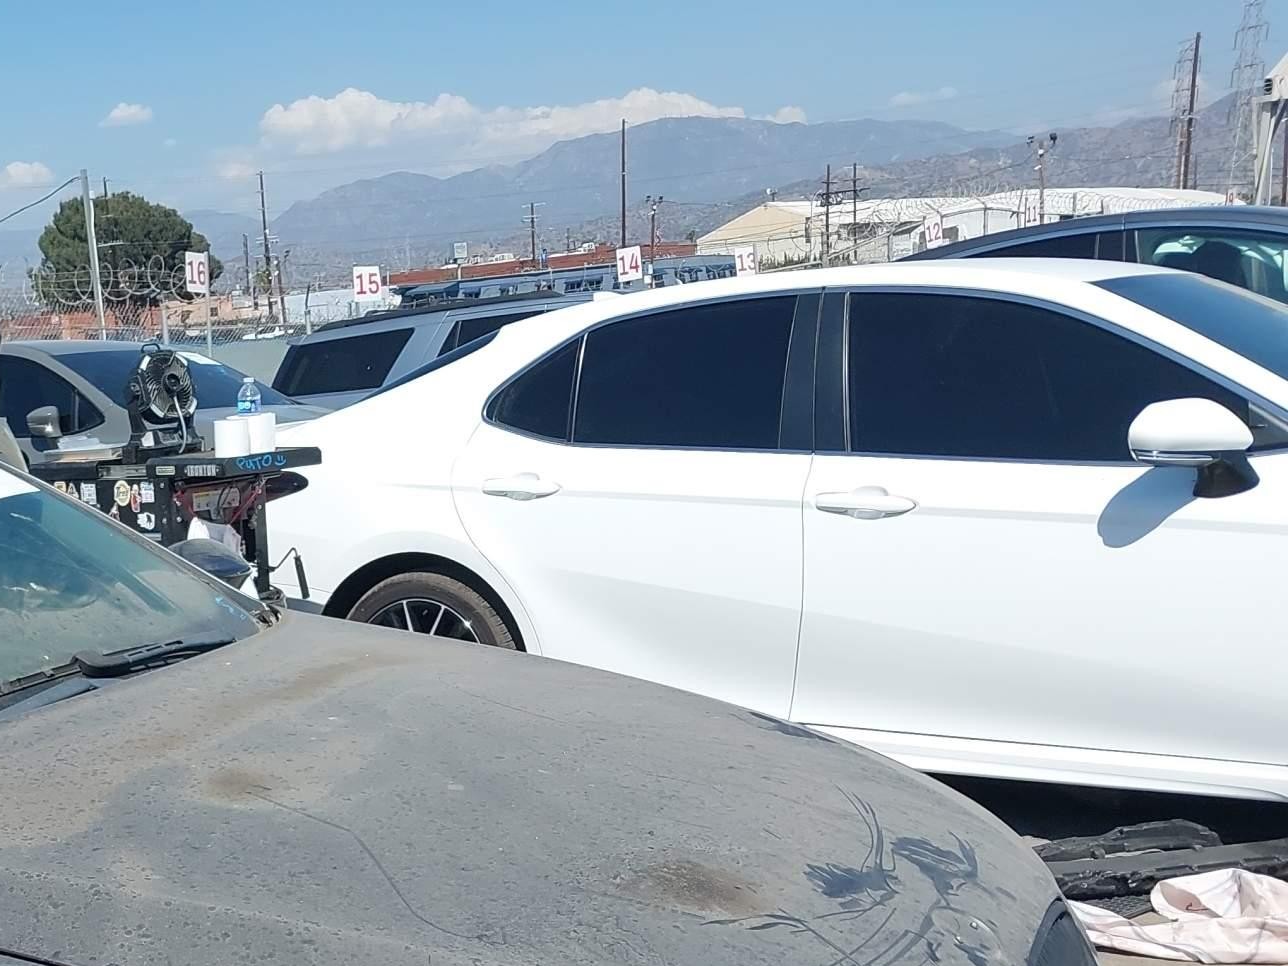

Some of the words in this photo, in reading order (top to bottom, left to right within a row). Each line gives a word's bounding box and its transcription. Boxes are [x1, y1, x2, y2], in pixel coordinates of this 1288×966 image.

[926, 222, 941, 243] 12
[187, 260, 206, 285] 16
[618, 252, 640, 276] 14
[737, 253, 755, 271] 13
[355, 272, 380, 295] 15
